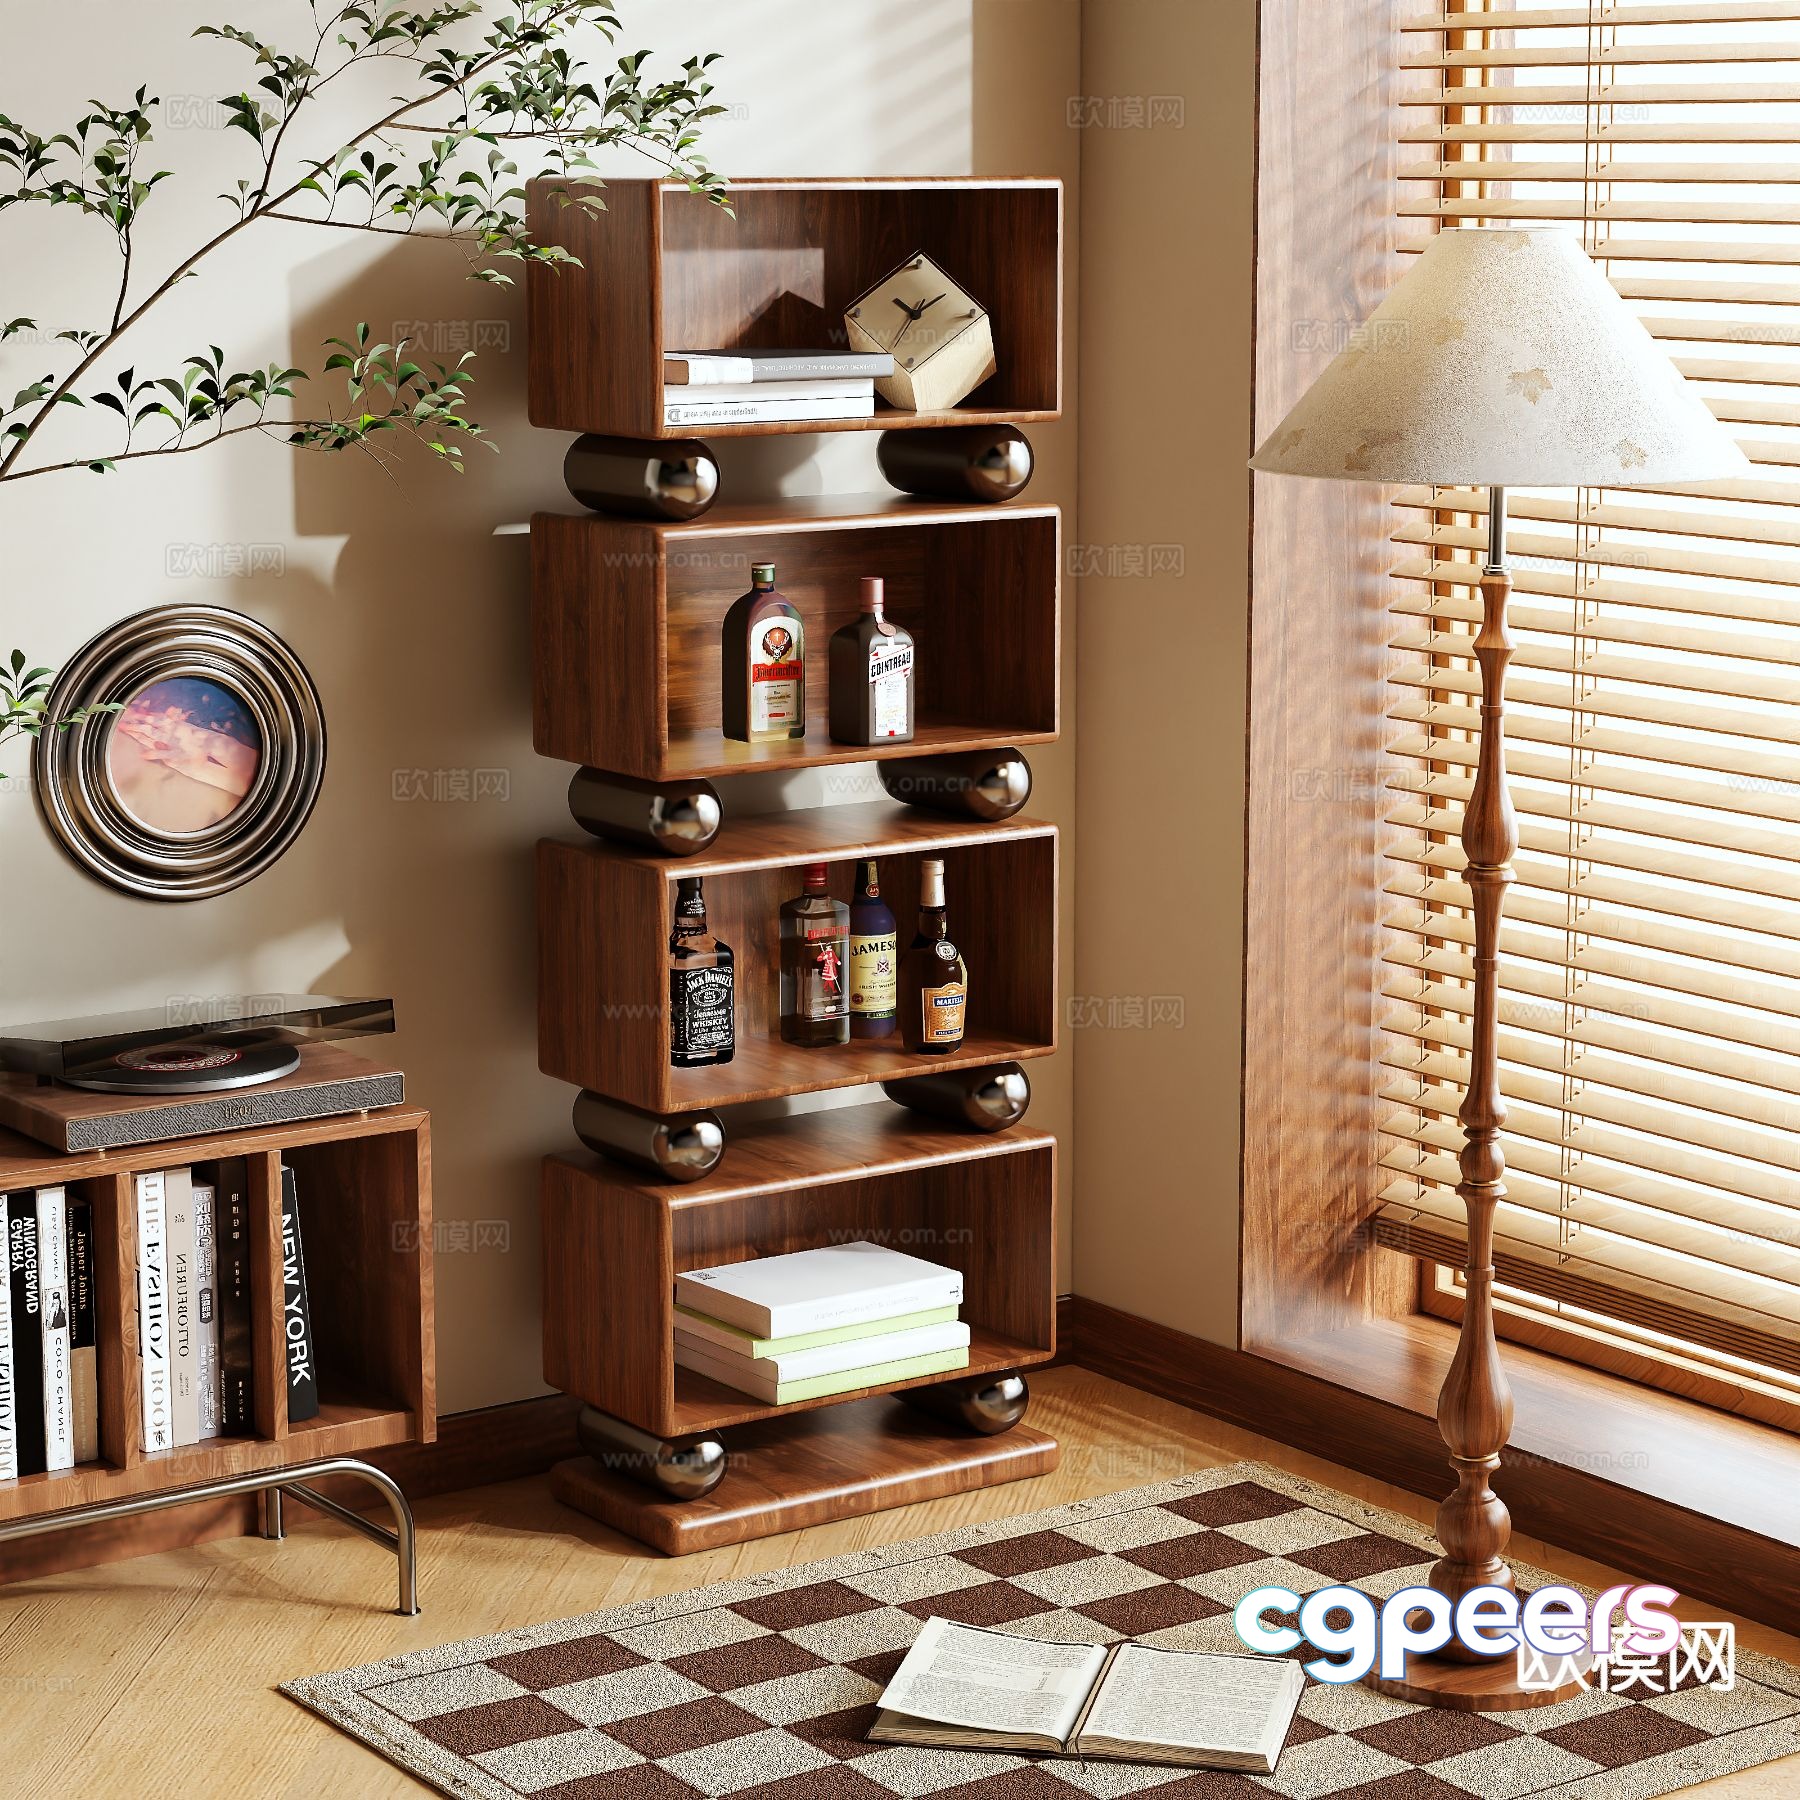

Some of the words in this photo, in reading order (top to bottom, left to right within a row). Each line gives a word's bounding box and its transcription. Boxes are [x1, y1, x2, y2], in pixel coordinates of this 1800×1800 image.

[870, 651, 911, 678] COINTREAU
[686, 975, 704, 993] JACK
[936, 997, 963, 1006] MARTELL
[692, 1017, 728, 1029] WHISKEY
[76, 1231, 86, 1271] Jasper
[281, 1212, 300, 1286] NEW
[78, 1274, 87, 1310] Johns
[284, 1292, 312, 1387] YORK
